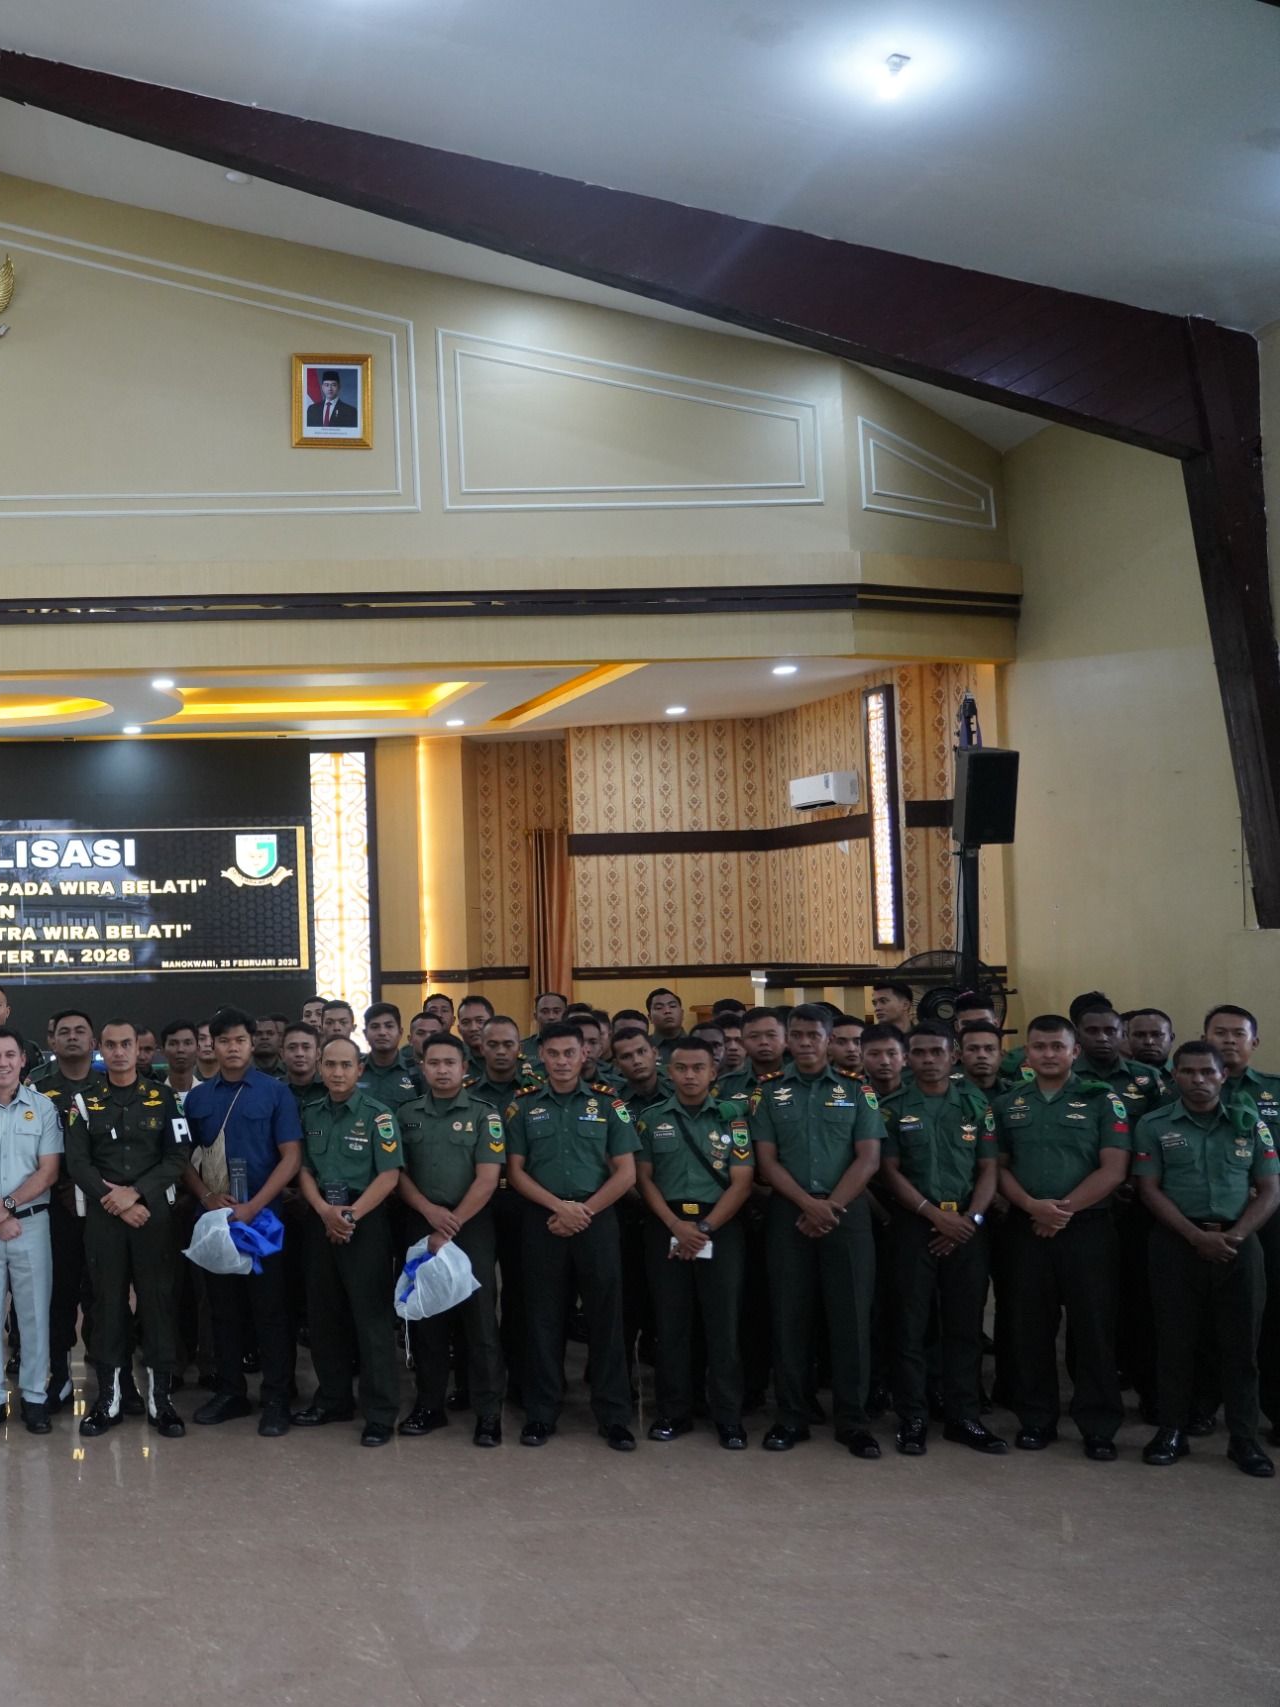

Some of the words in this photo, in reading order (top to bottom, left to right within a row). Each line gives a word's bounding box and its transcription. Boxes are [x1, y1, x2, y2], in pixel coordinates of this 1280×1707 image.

[59, 880, 115, 895] WIRA
[121, 879, 206, 894] BELATI"
[43, 925, 99, 940] WIRA
[106, 924, 191, 939] BELATI"
[41, 949, 74, 963] TA.
[81, 948, 130, 962] 2026
[233, 959, 276, 967] FEBRUARI
[171, 1117, 192, 1143] P
